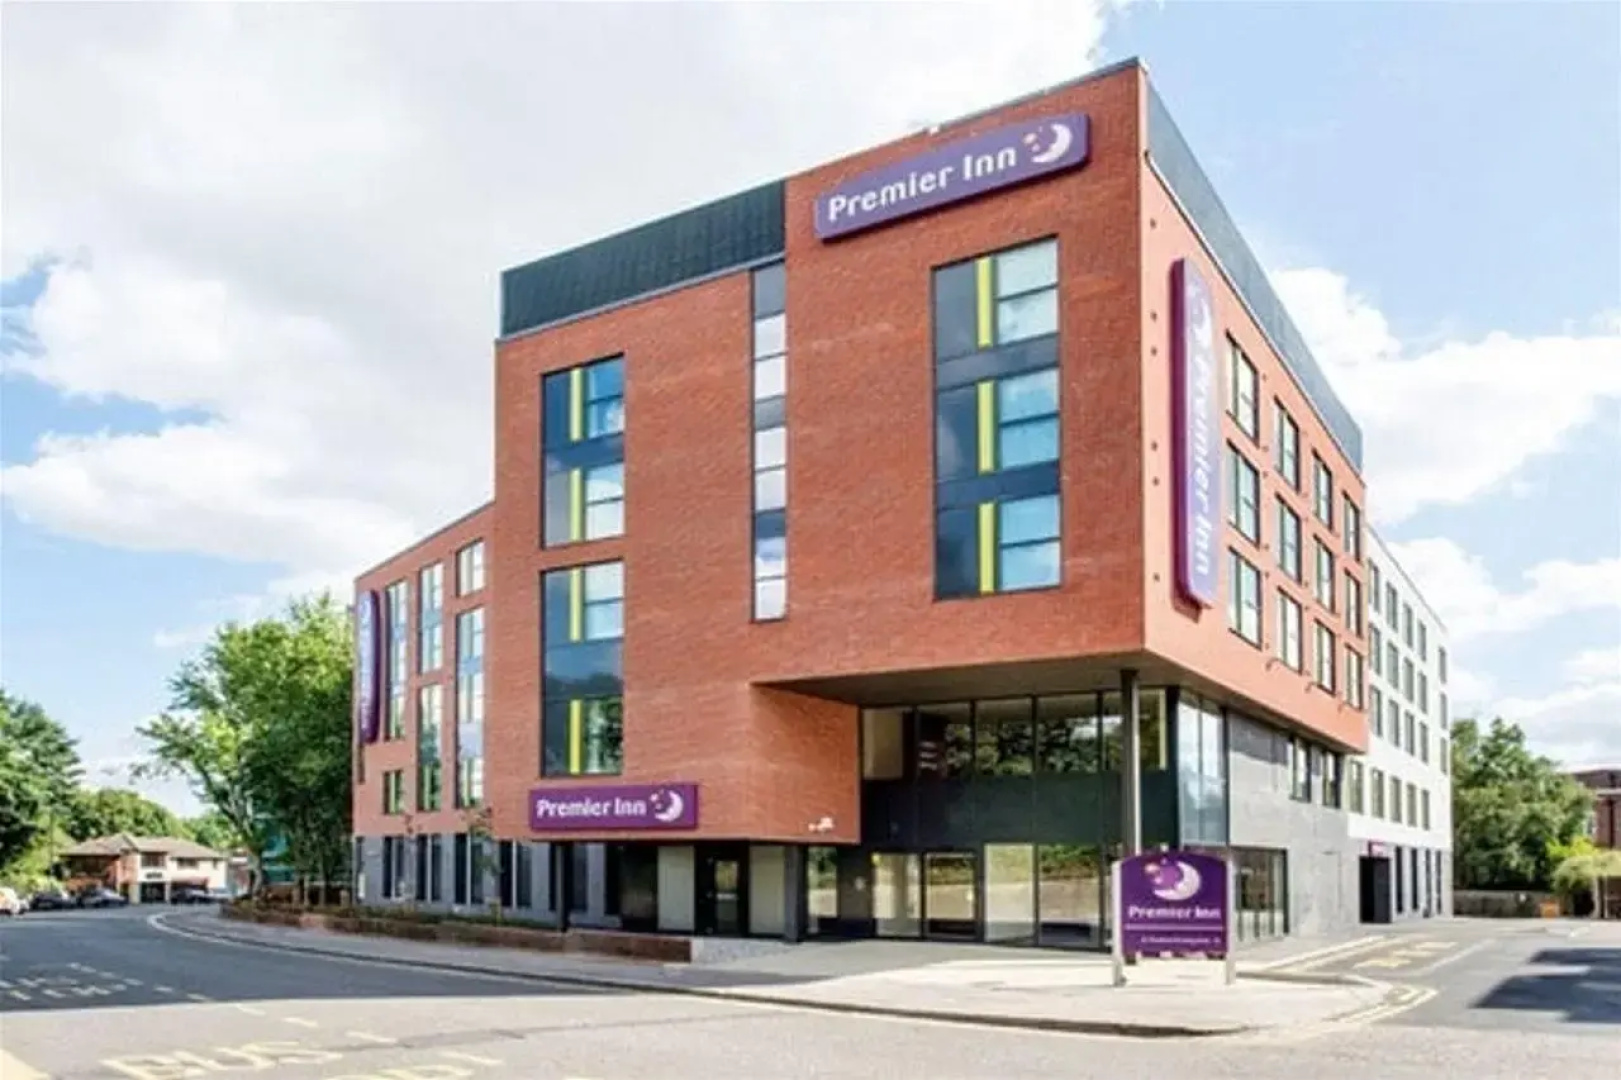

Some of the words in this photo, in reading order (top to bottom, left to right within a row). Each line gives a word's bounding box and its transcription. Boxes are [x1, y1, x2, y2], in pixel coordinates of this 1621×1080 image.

[828, 165, 953, 221] Premier
[962, 146, 1016, 180] Inn
[1194, 514, 1212, 575] Inn
[536, 798, 611, 819] Premier
[614, 797, 647, 816] Inn
